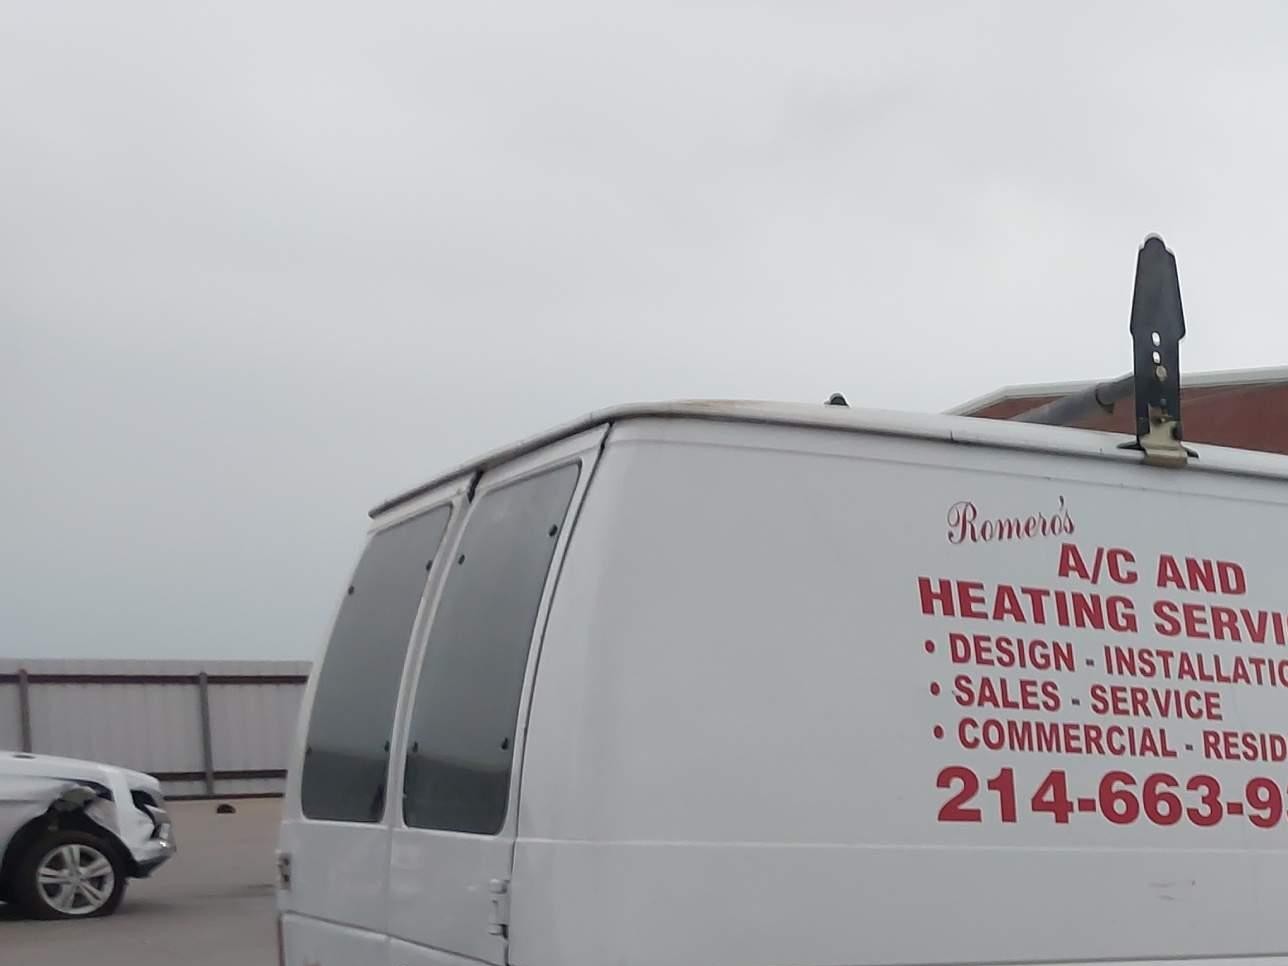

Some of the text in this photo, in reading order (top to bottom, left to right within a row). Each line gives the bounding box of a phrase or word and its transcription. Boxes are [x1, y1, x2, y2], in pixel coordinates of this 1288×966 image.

[946, 495, 1076, 545] Romero's
[1058, 542, 1247, 597] A/C AND
[917, 576, 1139, 633] HEATING
[948, 632, 1076, 673] DESIGN
[954, 674, 1062, 713] SALES
[1089, 684, 1224, 721] SERVICE
[957, 716, 1178, 759] COMMERCIAL
